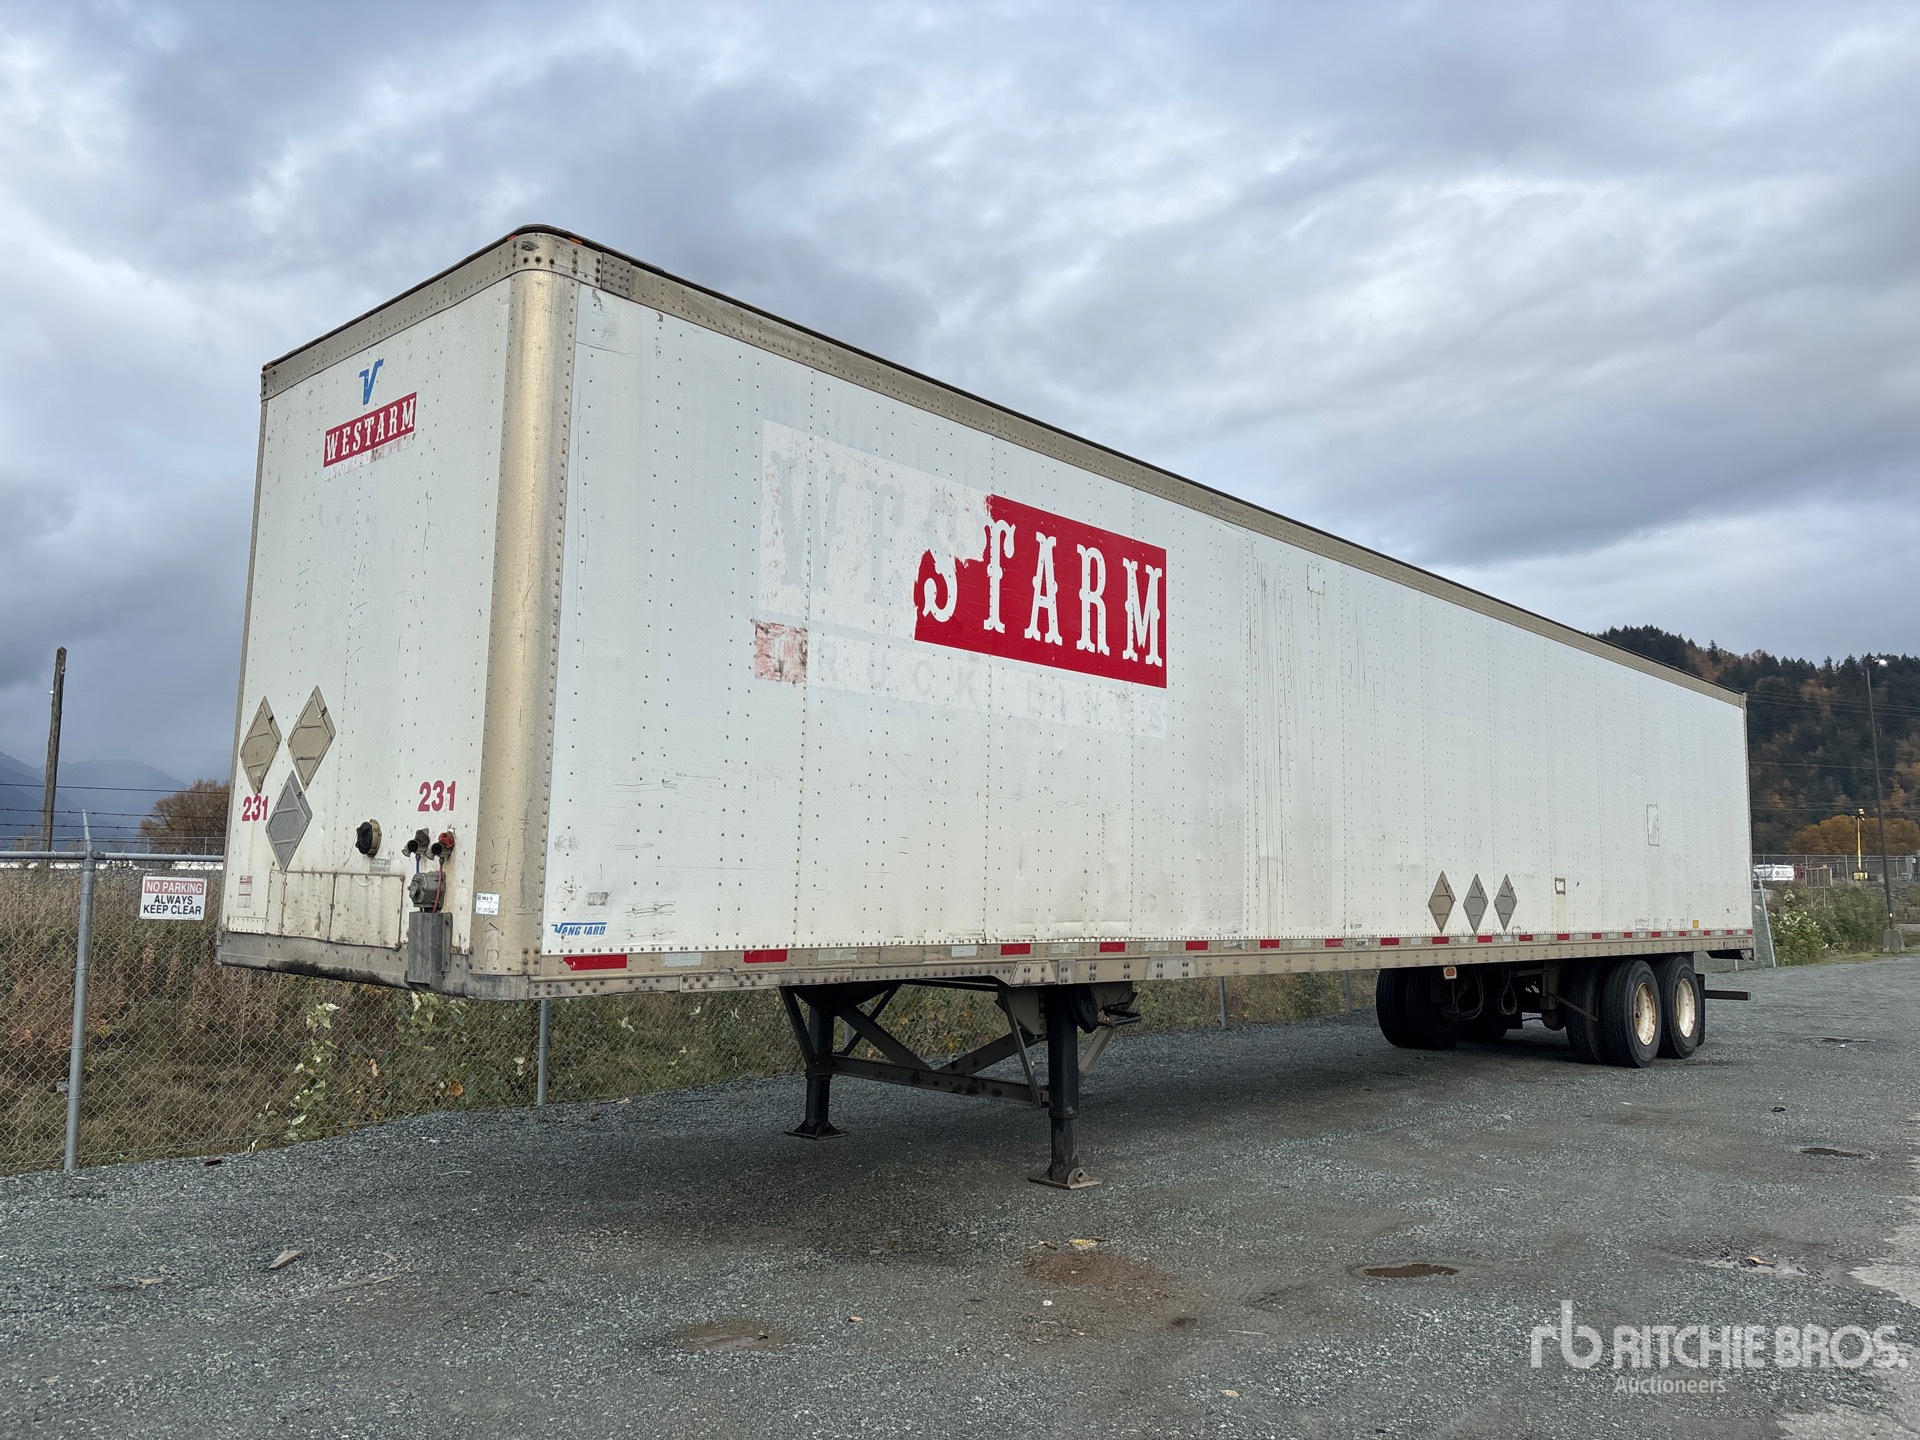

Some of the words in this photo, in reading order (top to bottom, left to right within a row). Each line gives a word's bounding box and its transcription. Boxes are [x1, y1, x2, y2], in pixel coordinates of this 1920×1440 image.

[325, 397, 416, 462] WESTARM
[417, 780, 456, 812] 231
[241, 795, 269, 822] 231
[146, 881, 160, 892] NO
[162, 881, 202, 894] PARKING
[143, 904, 168, 914] KEEP
[170, 905, 202, 915] CLEAR
[153, 895, 193, 905] ALWAYS
